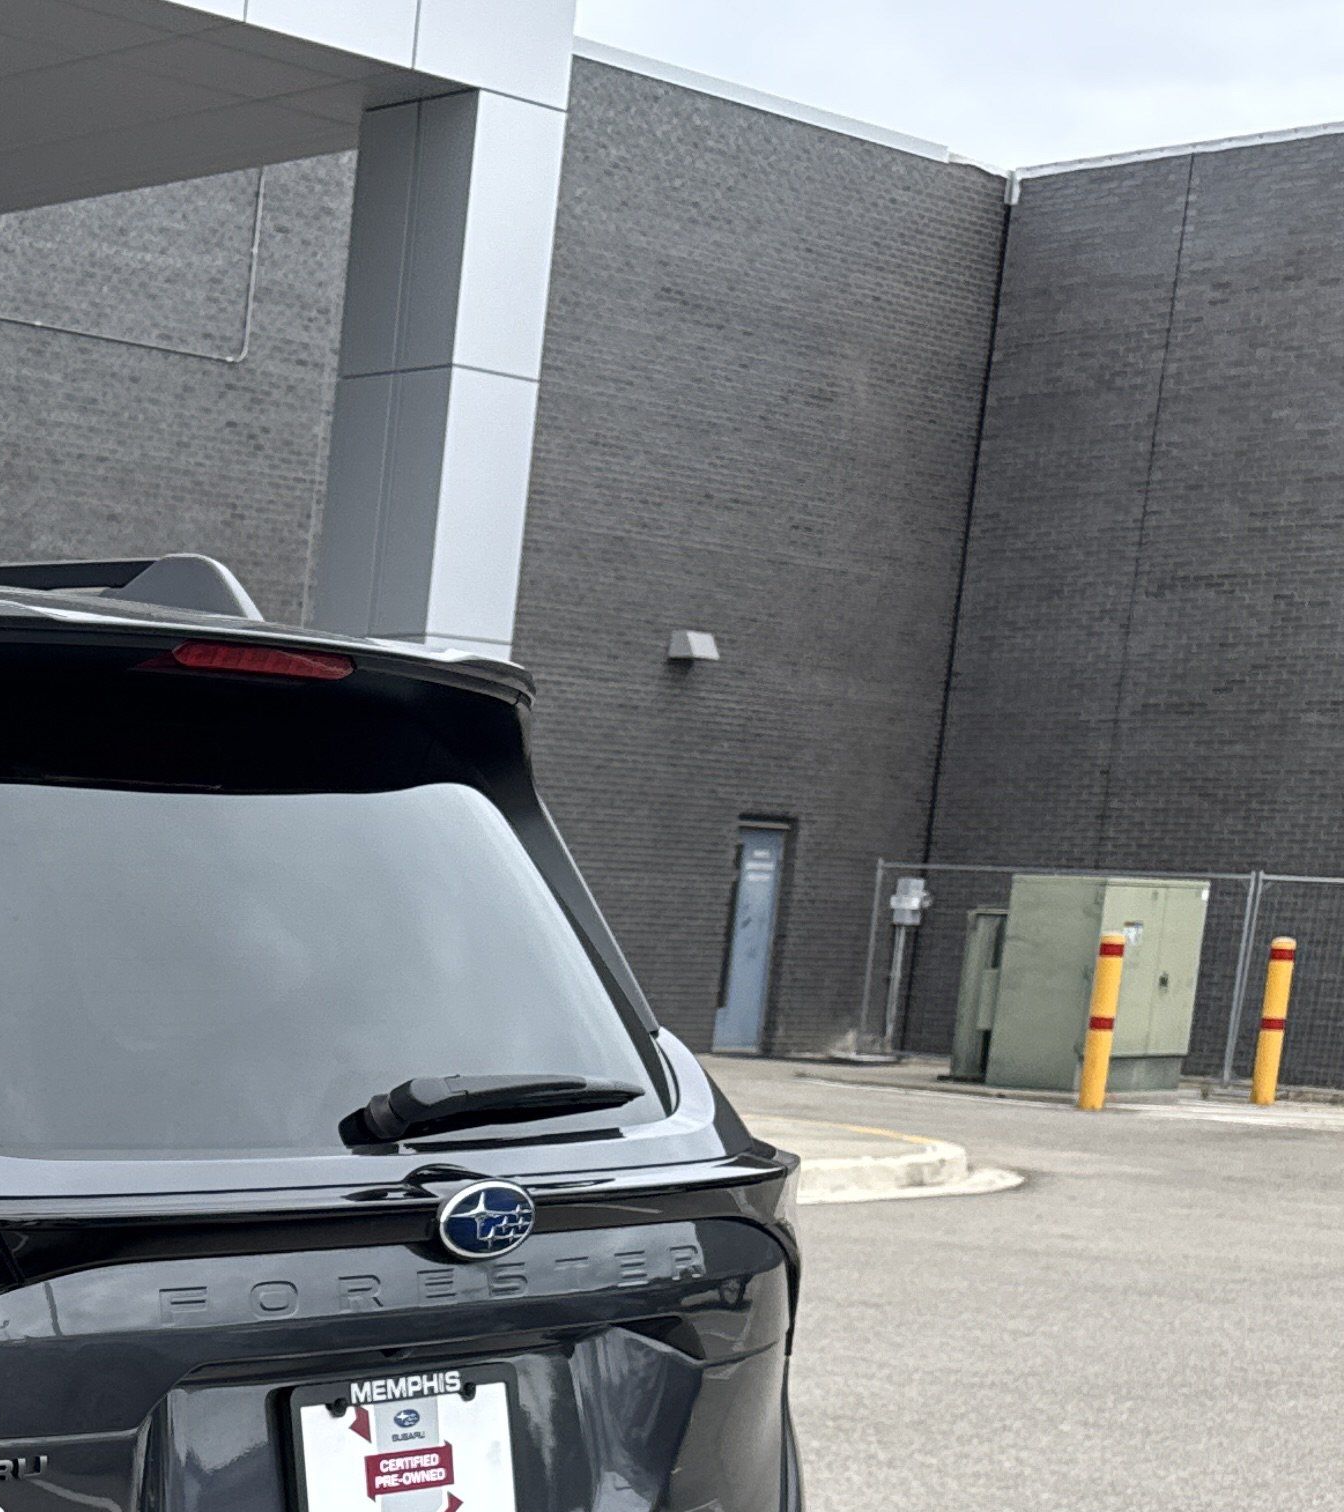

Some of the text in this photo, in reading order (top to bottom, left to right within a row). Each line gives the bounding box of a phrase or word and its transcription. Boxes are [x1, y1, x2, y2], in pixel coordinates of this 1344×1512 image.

[158, 1245, 707, 1325] FORESTER
[349, 1370, 461, 1405] MEMPHIS
[379, 1452, 440, 1473] CERTIFIED
[374, 1467, 447, 1489] PRE-OWNED
